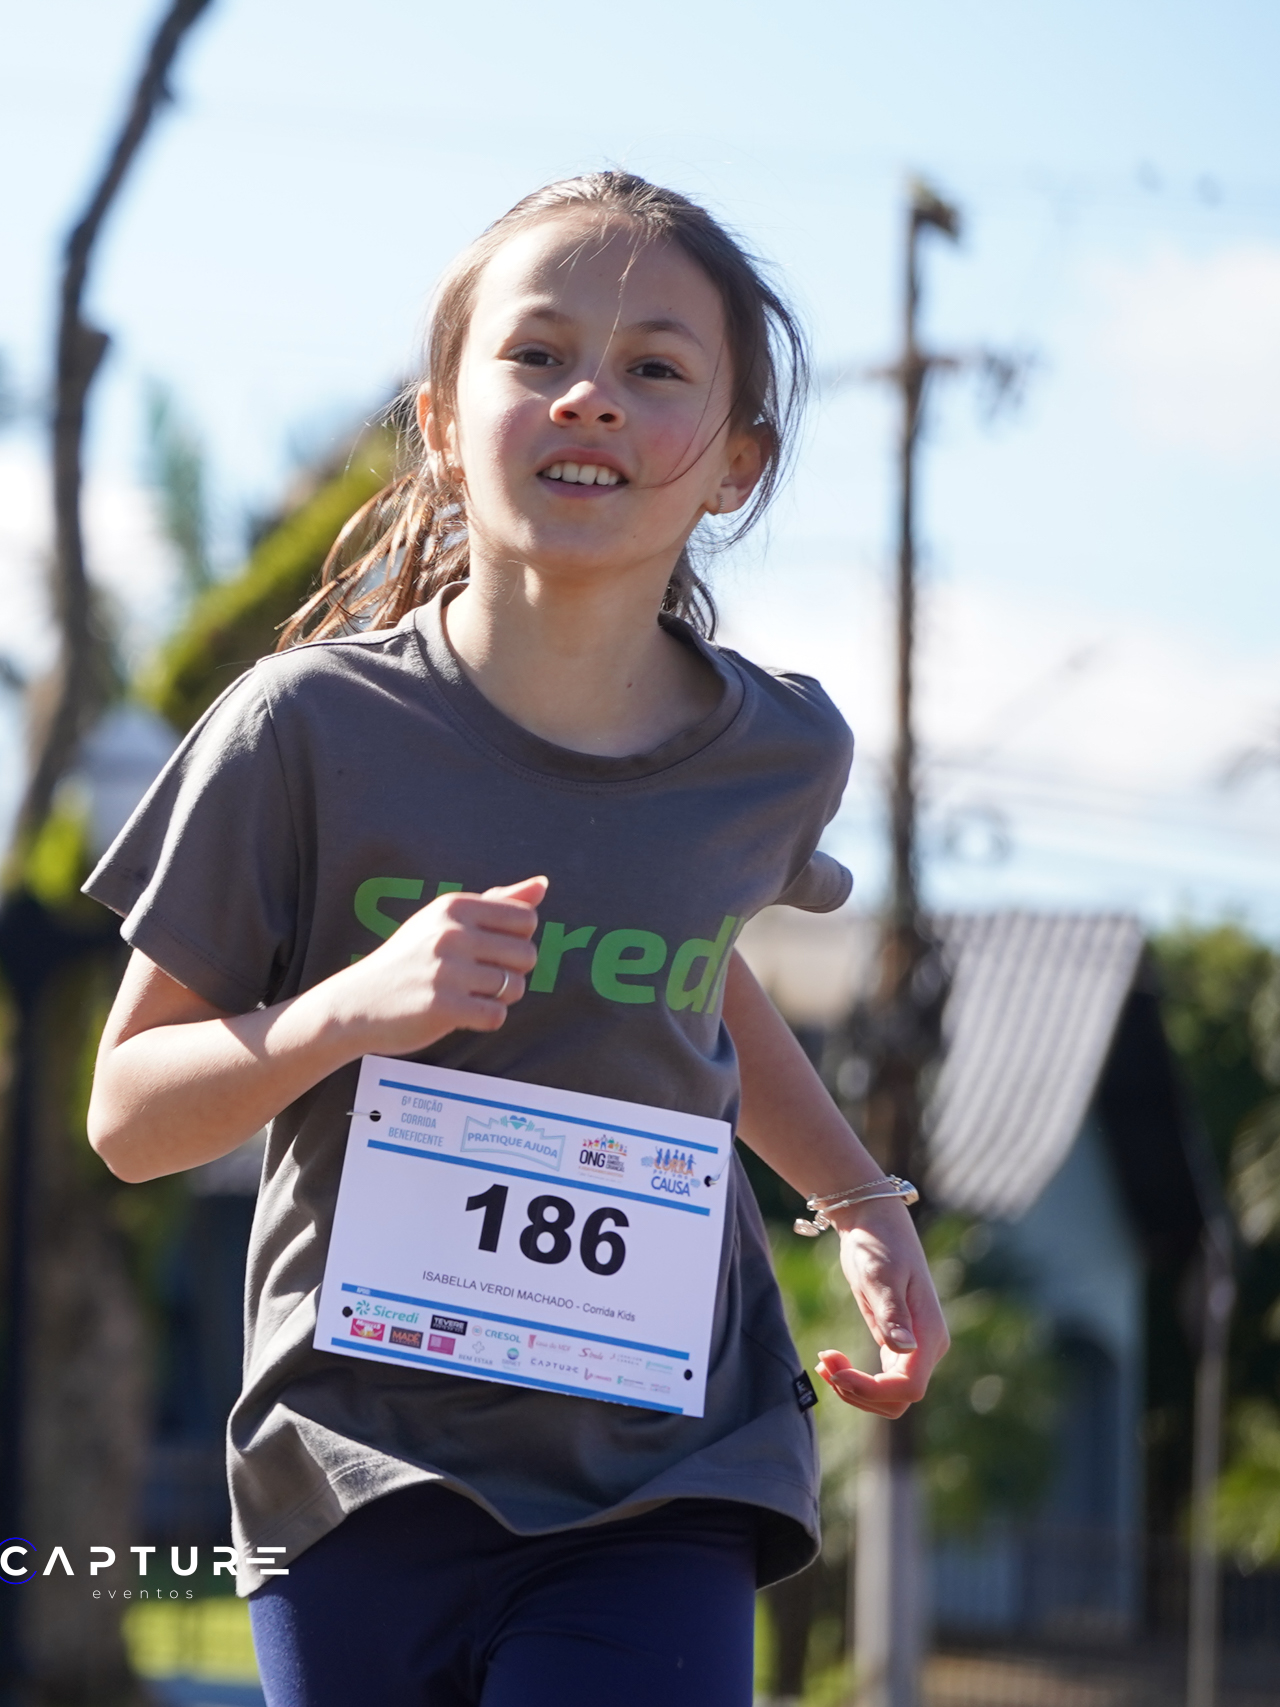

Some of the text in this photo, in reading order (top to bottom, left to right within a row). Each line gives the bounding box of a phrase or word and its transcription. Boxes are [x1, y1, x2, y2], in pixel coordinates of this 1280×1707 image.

[413, 1097, 443, 1113] EDIÇÃO
[401, 1112, 437, 1128] CORRIDA
[388, 1126, 444, 1147] BENEFICENTE
[467, 1132, 558, 1158] PRATIQUE AJUDA
[579, 1149, 606, 1168] ONG
[651, 1176, 690, 1197] CAUSA
[465, 1183, 630, 1276] 186
[422, 1270, 477, 1290] ISABELLA
[480, 1281, 515, 1298] VERDI
[517, 1289, 574, 1309] MACHADO
[582, 1302, 615, 1319] Corrida
[617, 1310, 636, 1322] Kids
[372, 1305, 420, 1324] Sicredi
[485, 1329, 521, 1343] CRESOL
[531, 1358, 579, 1373] CAPTURE
